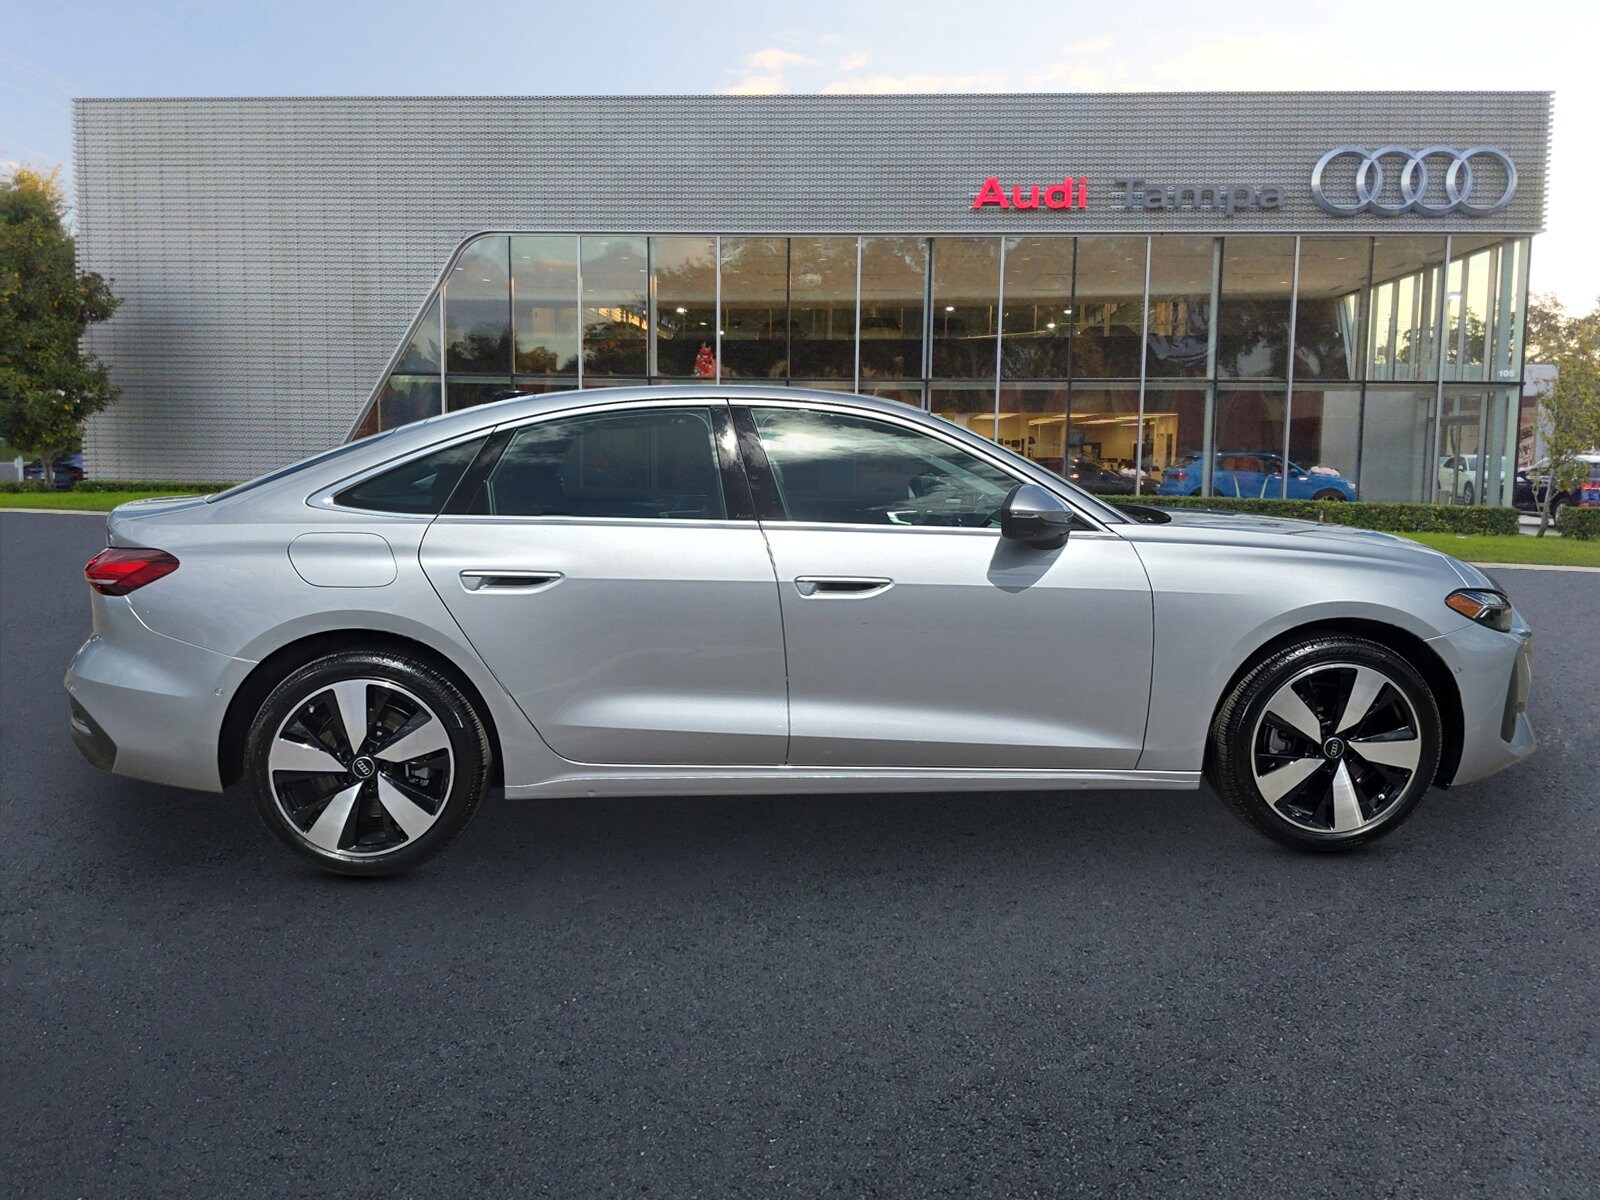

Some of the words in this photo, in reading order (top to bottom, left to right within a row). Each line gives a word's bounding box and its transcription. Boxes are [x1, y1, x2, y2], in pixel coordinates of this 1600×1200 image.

[972, 176, 1088, 209] Audi
[1113, 178, 1285, 218] Tampa
[1499, 370, 1515, 378] 105
